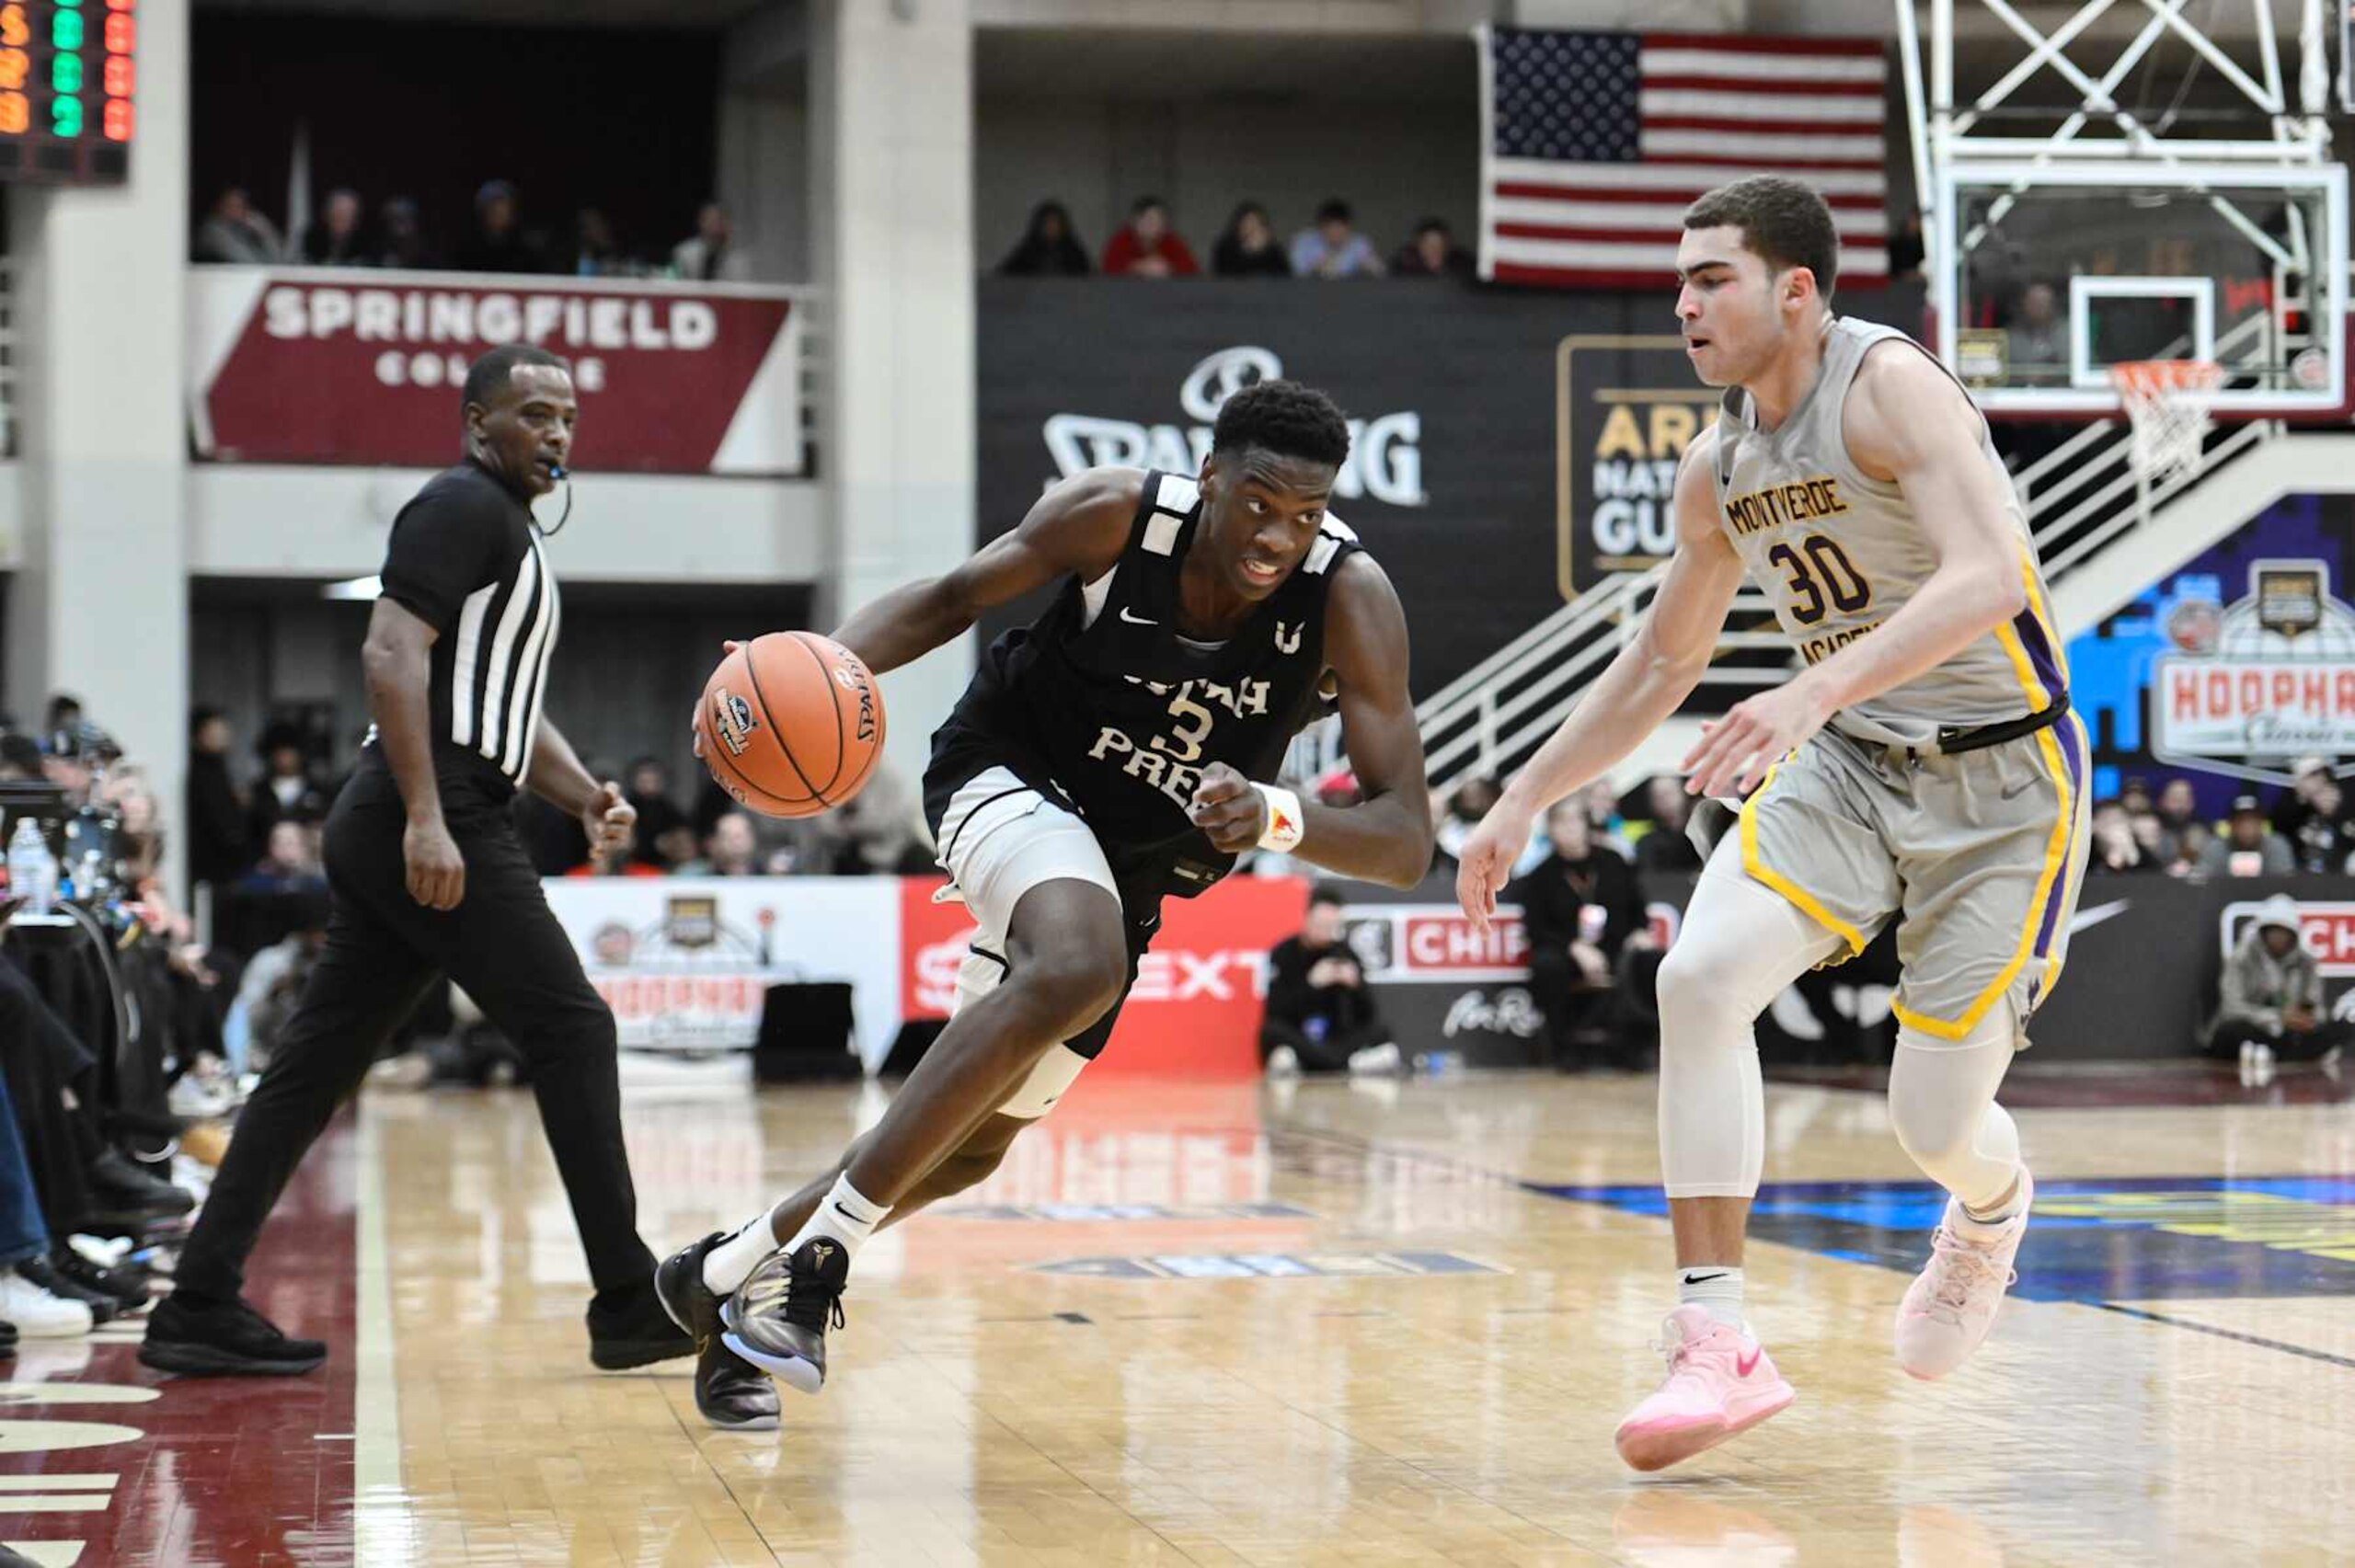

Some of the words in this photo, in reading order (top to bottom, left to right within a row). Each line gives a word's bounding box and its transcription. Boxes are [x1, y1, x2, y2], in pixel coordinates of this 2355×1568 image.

[264, 287, 718, 350] SPRINGFIELD
[374, 350, 606, 393] COLE
[1768, 533, 1871, 625] 30
[2173, 669, 2355, 723] HOOPHA
[1149, 700, 1214, 762] 3
[1087, 726, 1204, 826] PRE
[1410, 921, 1527, 965] CHIP
